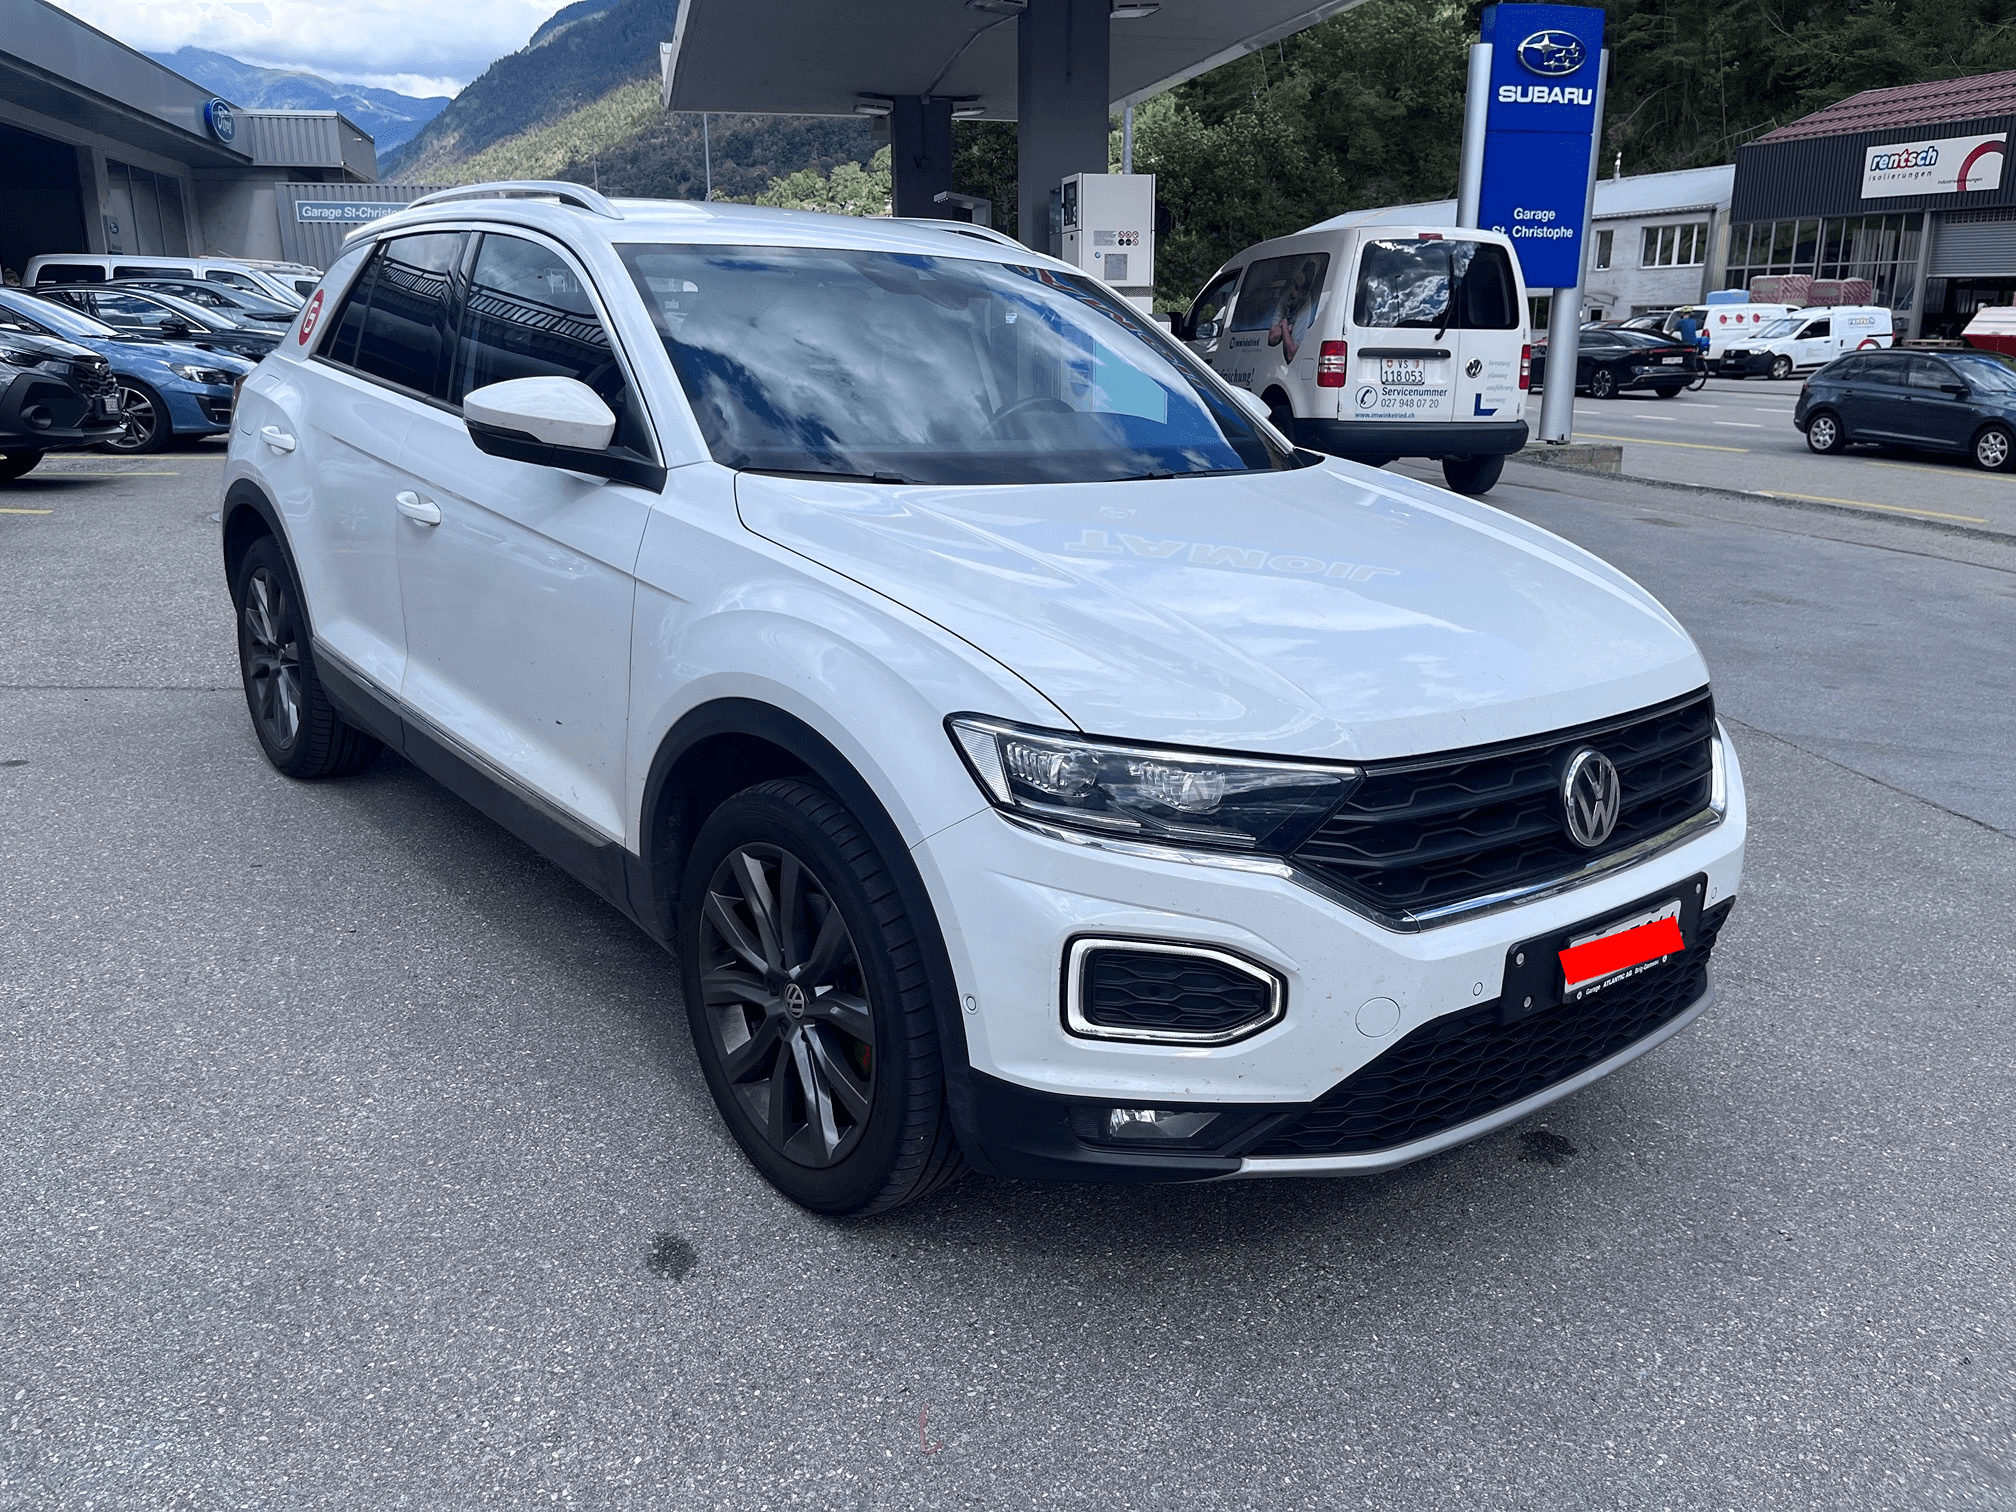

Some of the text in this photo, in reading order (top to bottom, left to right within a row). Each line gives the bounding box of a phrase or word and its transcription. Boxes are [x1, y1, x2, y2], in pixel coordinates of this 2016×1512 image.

[1498, 85, 1593, 105] SUBARU
[1870, 146, 1939, 171] rentsch
[1868, 171, 1932, 182] isolierungen
[302, 206, 342, 219] Garage
[1513, 208, 1556, 222] Garage
[1512, 225, 1574, 240] Christophe
[1398, 359, 1409, 369] VS
[1384, 370, 1423, 382] 118 053
[1382, 387, 1448, 397] Servicenummer
[1381, 399, 1439, 408] 027 948 07 20
[1585, 984, 1601, 995] Garage
[1603, 973, 1625, 988] ATLANTIC
